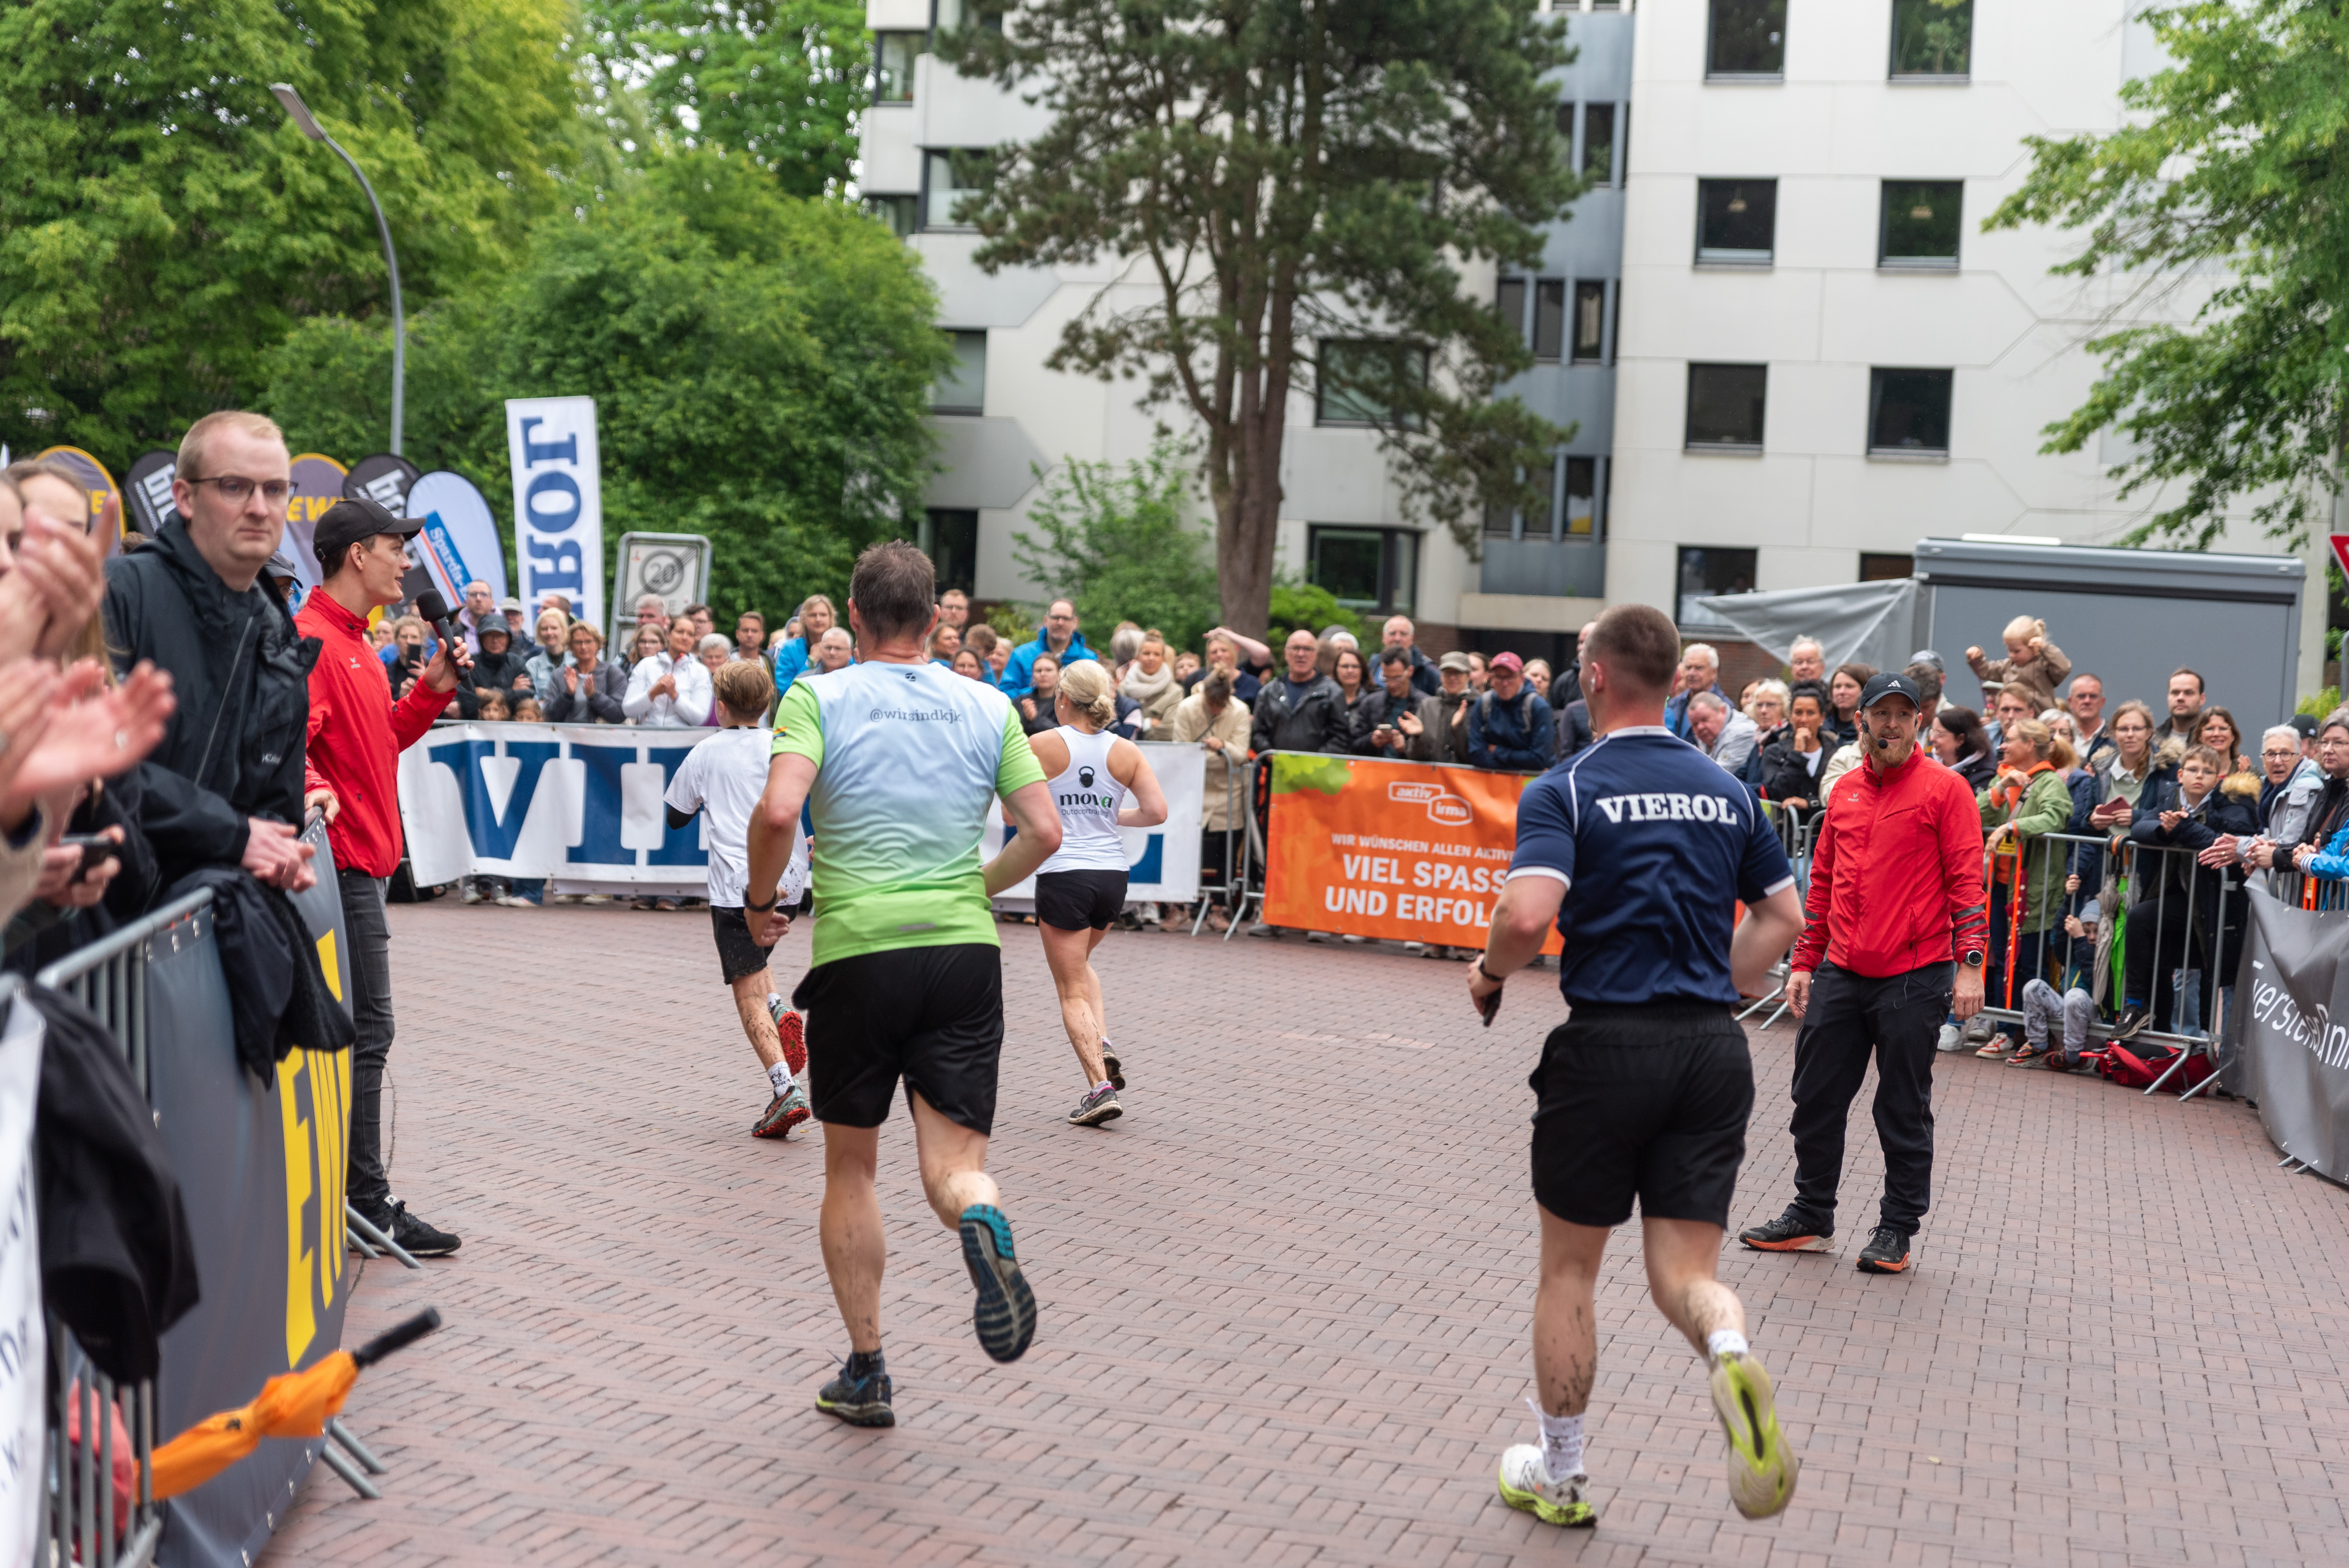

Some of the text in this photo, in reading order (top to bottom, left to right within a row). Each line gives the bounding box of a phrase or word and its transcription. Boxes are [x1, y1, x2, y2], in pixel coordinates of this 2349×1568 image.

[870, 708, 962, 723] @wirsindkjk
[1396, 784, 1432, 799] aktiv
[1436, 801, 1467, 817] irma
[1595, 792, 1737, 826] VIEROL
[1331, 833, 1515, 862] WIR WÜNSCHEN ALLEN AKTIVE
[1342, 853, 1508, 895] VIEL SPASS
[1324, 885, 1492, 928] UND ERFOL
